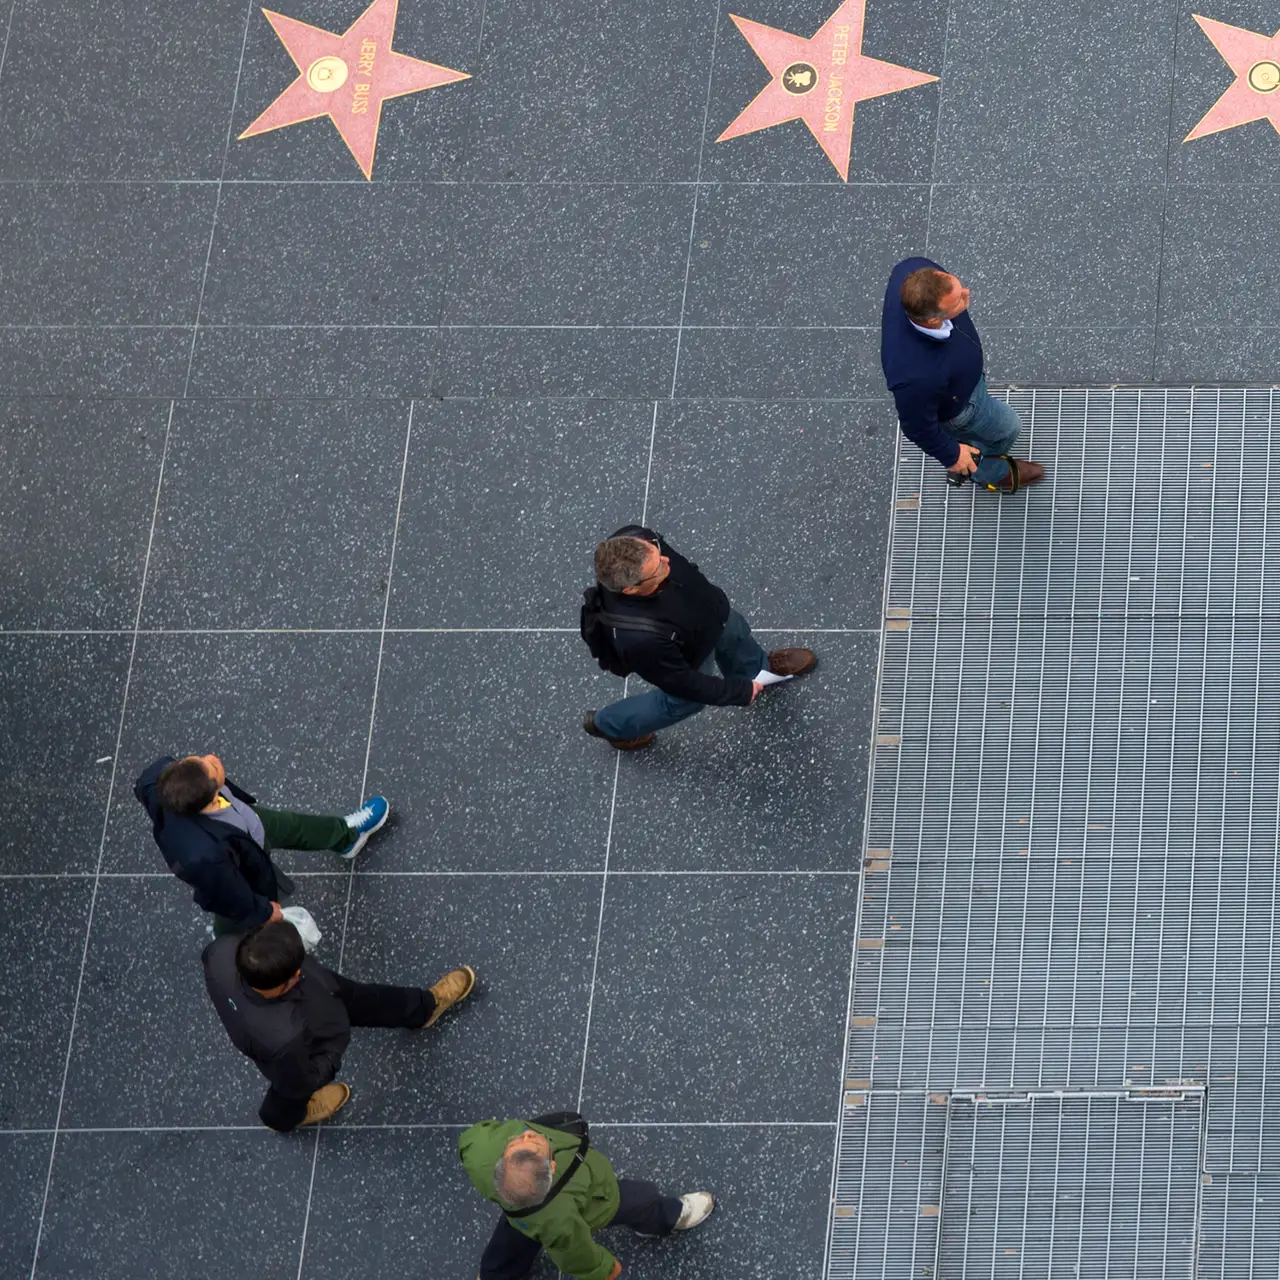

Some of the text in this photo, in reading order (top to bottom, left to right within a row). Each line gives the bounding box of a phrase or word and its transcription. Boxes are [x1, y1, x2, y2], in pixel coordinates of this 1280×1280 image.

[351, 38, 377, 115] JERRY BUSS
[823, 25, 851, 132] PETER JACKSON
